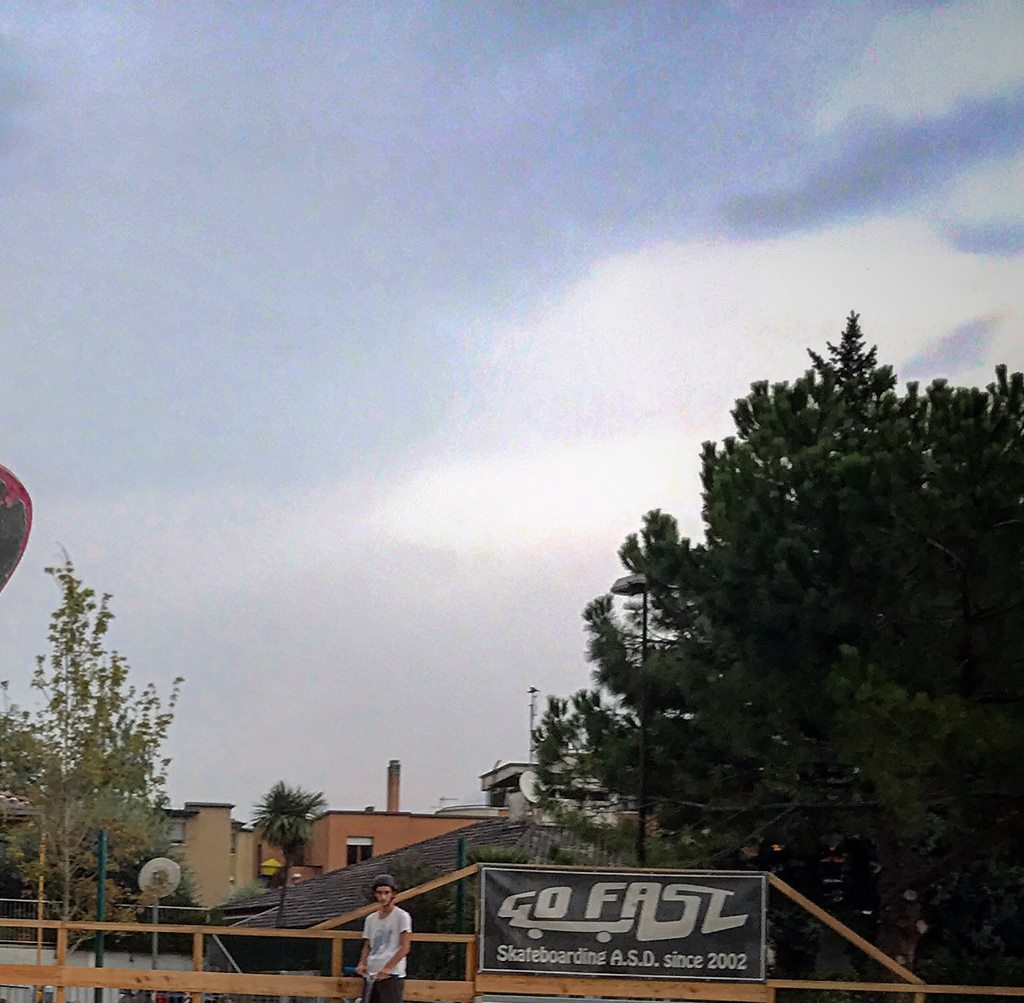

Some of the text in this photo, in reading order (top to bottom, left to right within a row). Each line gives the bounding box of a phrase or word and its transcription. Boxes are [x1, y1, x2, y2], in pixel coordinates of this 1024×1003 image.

[497, 881, 749, 942] GO FAST
[496, 944, 748, 970] Skateboarding A.S.D. since 2002
